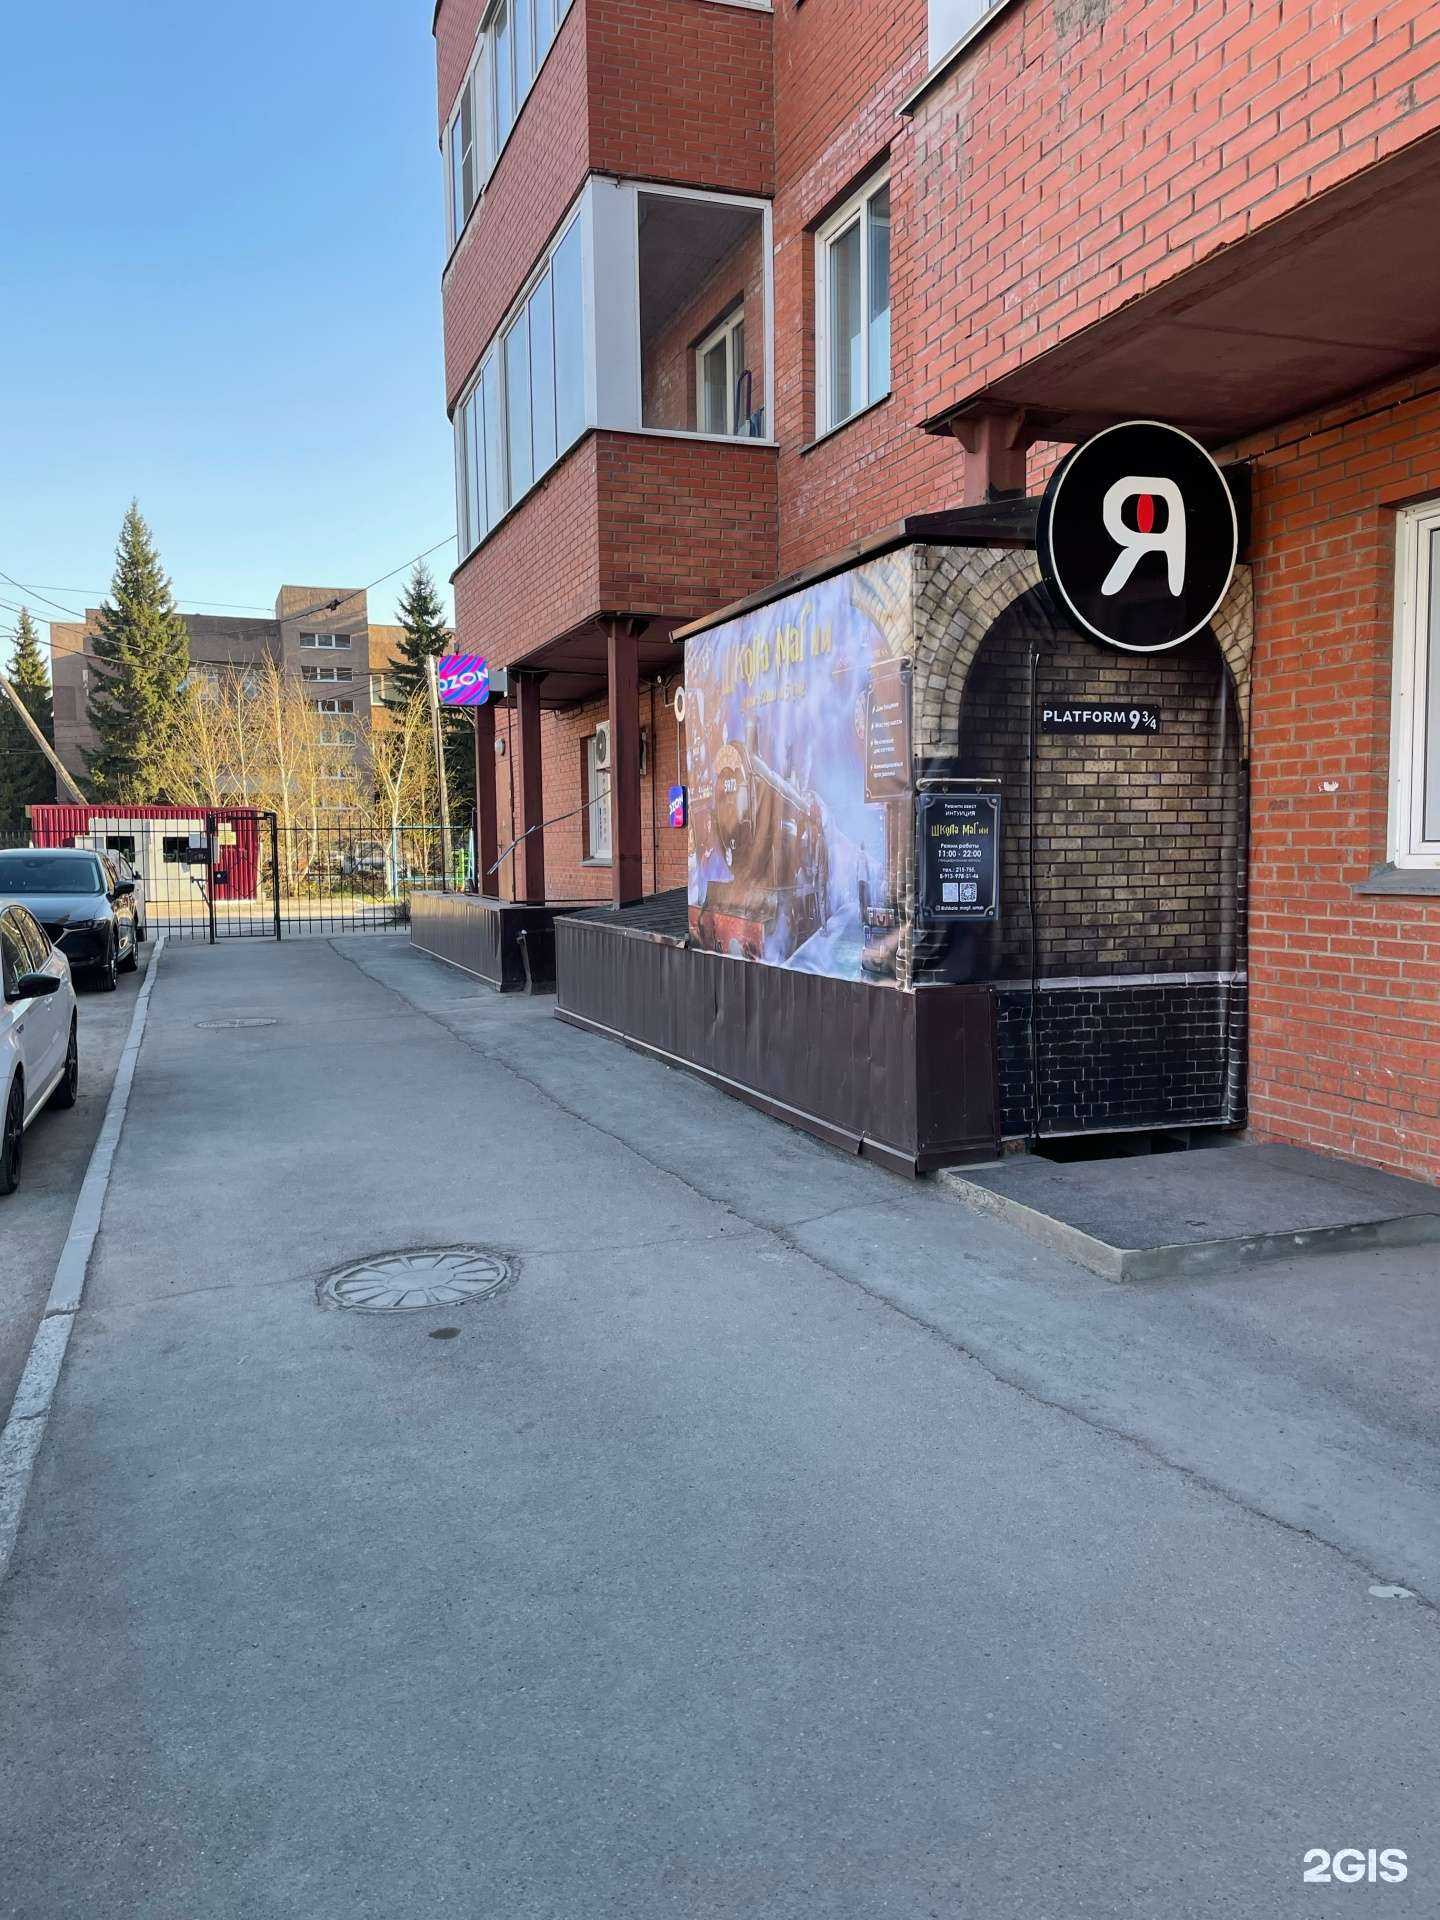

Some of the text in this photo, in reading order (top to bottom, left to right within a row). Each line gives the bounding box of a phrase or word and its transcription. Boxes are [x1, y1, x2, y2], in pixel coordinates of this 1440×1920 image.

[438, 668, 489, 692] OZON
[1043, 710, 1126, 722] PLATFORM
[938, 850, 957, 858] 11:00
[962, 850, 982, 858] 22:00
